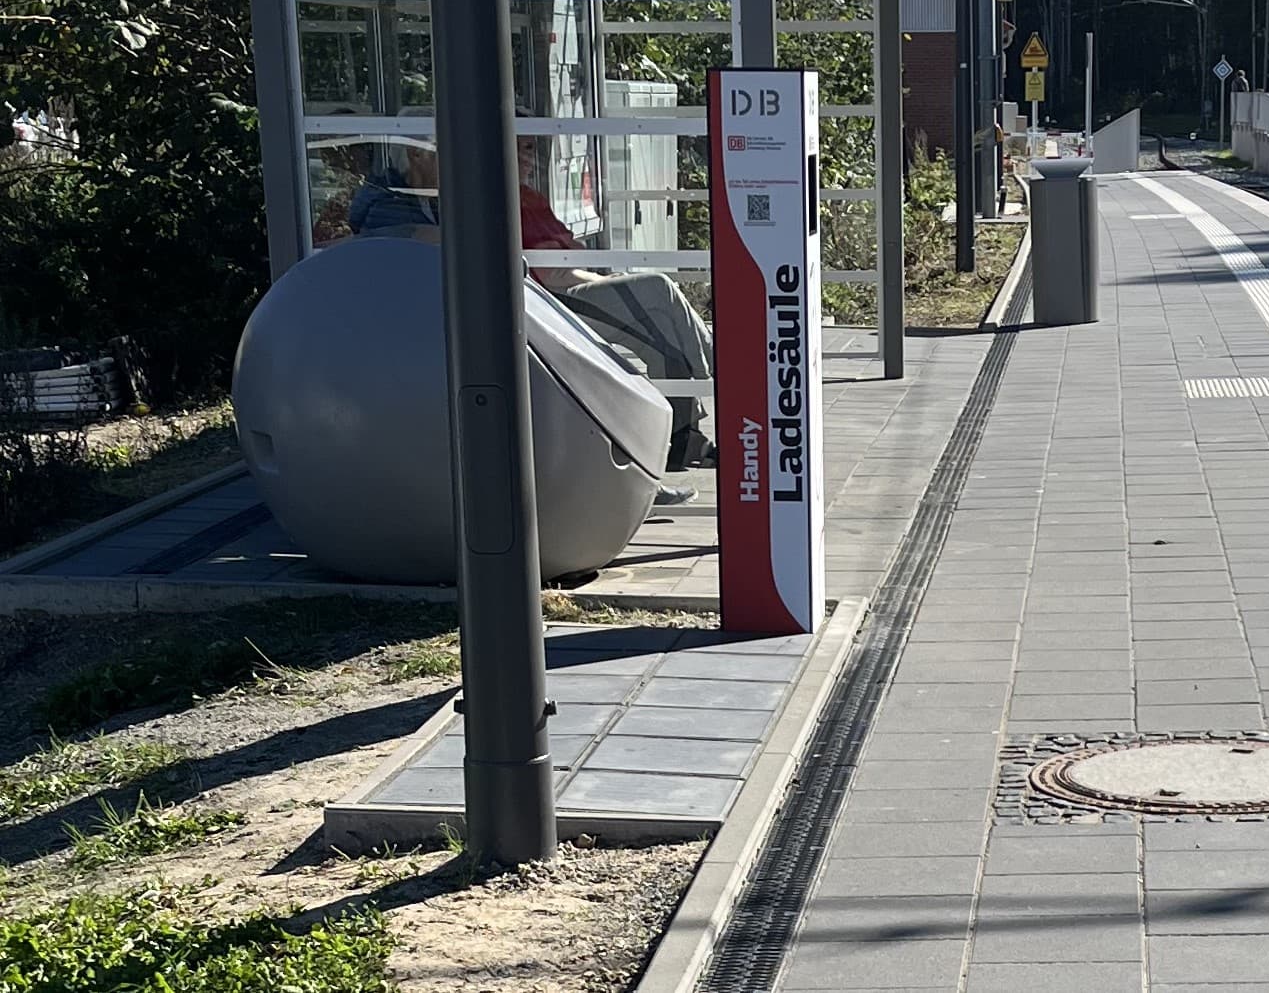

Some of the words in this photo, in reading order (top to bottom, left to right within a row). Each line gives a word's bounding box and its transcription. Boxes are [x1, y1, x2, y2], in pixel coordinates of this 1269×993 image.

[731, 89, 780, 116] DB
[730, 137, 744, 150] DB
[769, 264, 804, 502] Ladesäule
[739, 417, 763, 502] Handy
